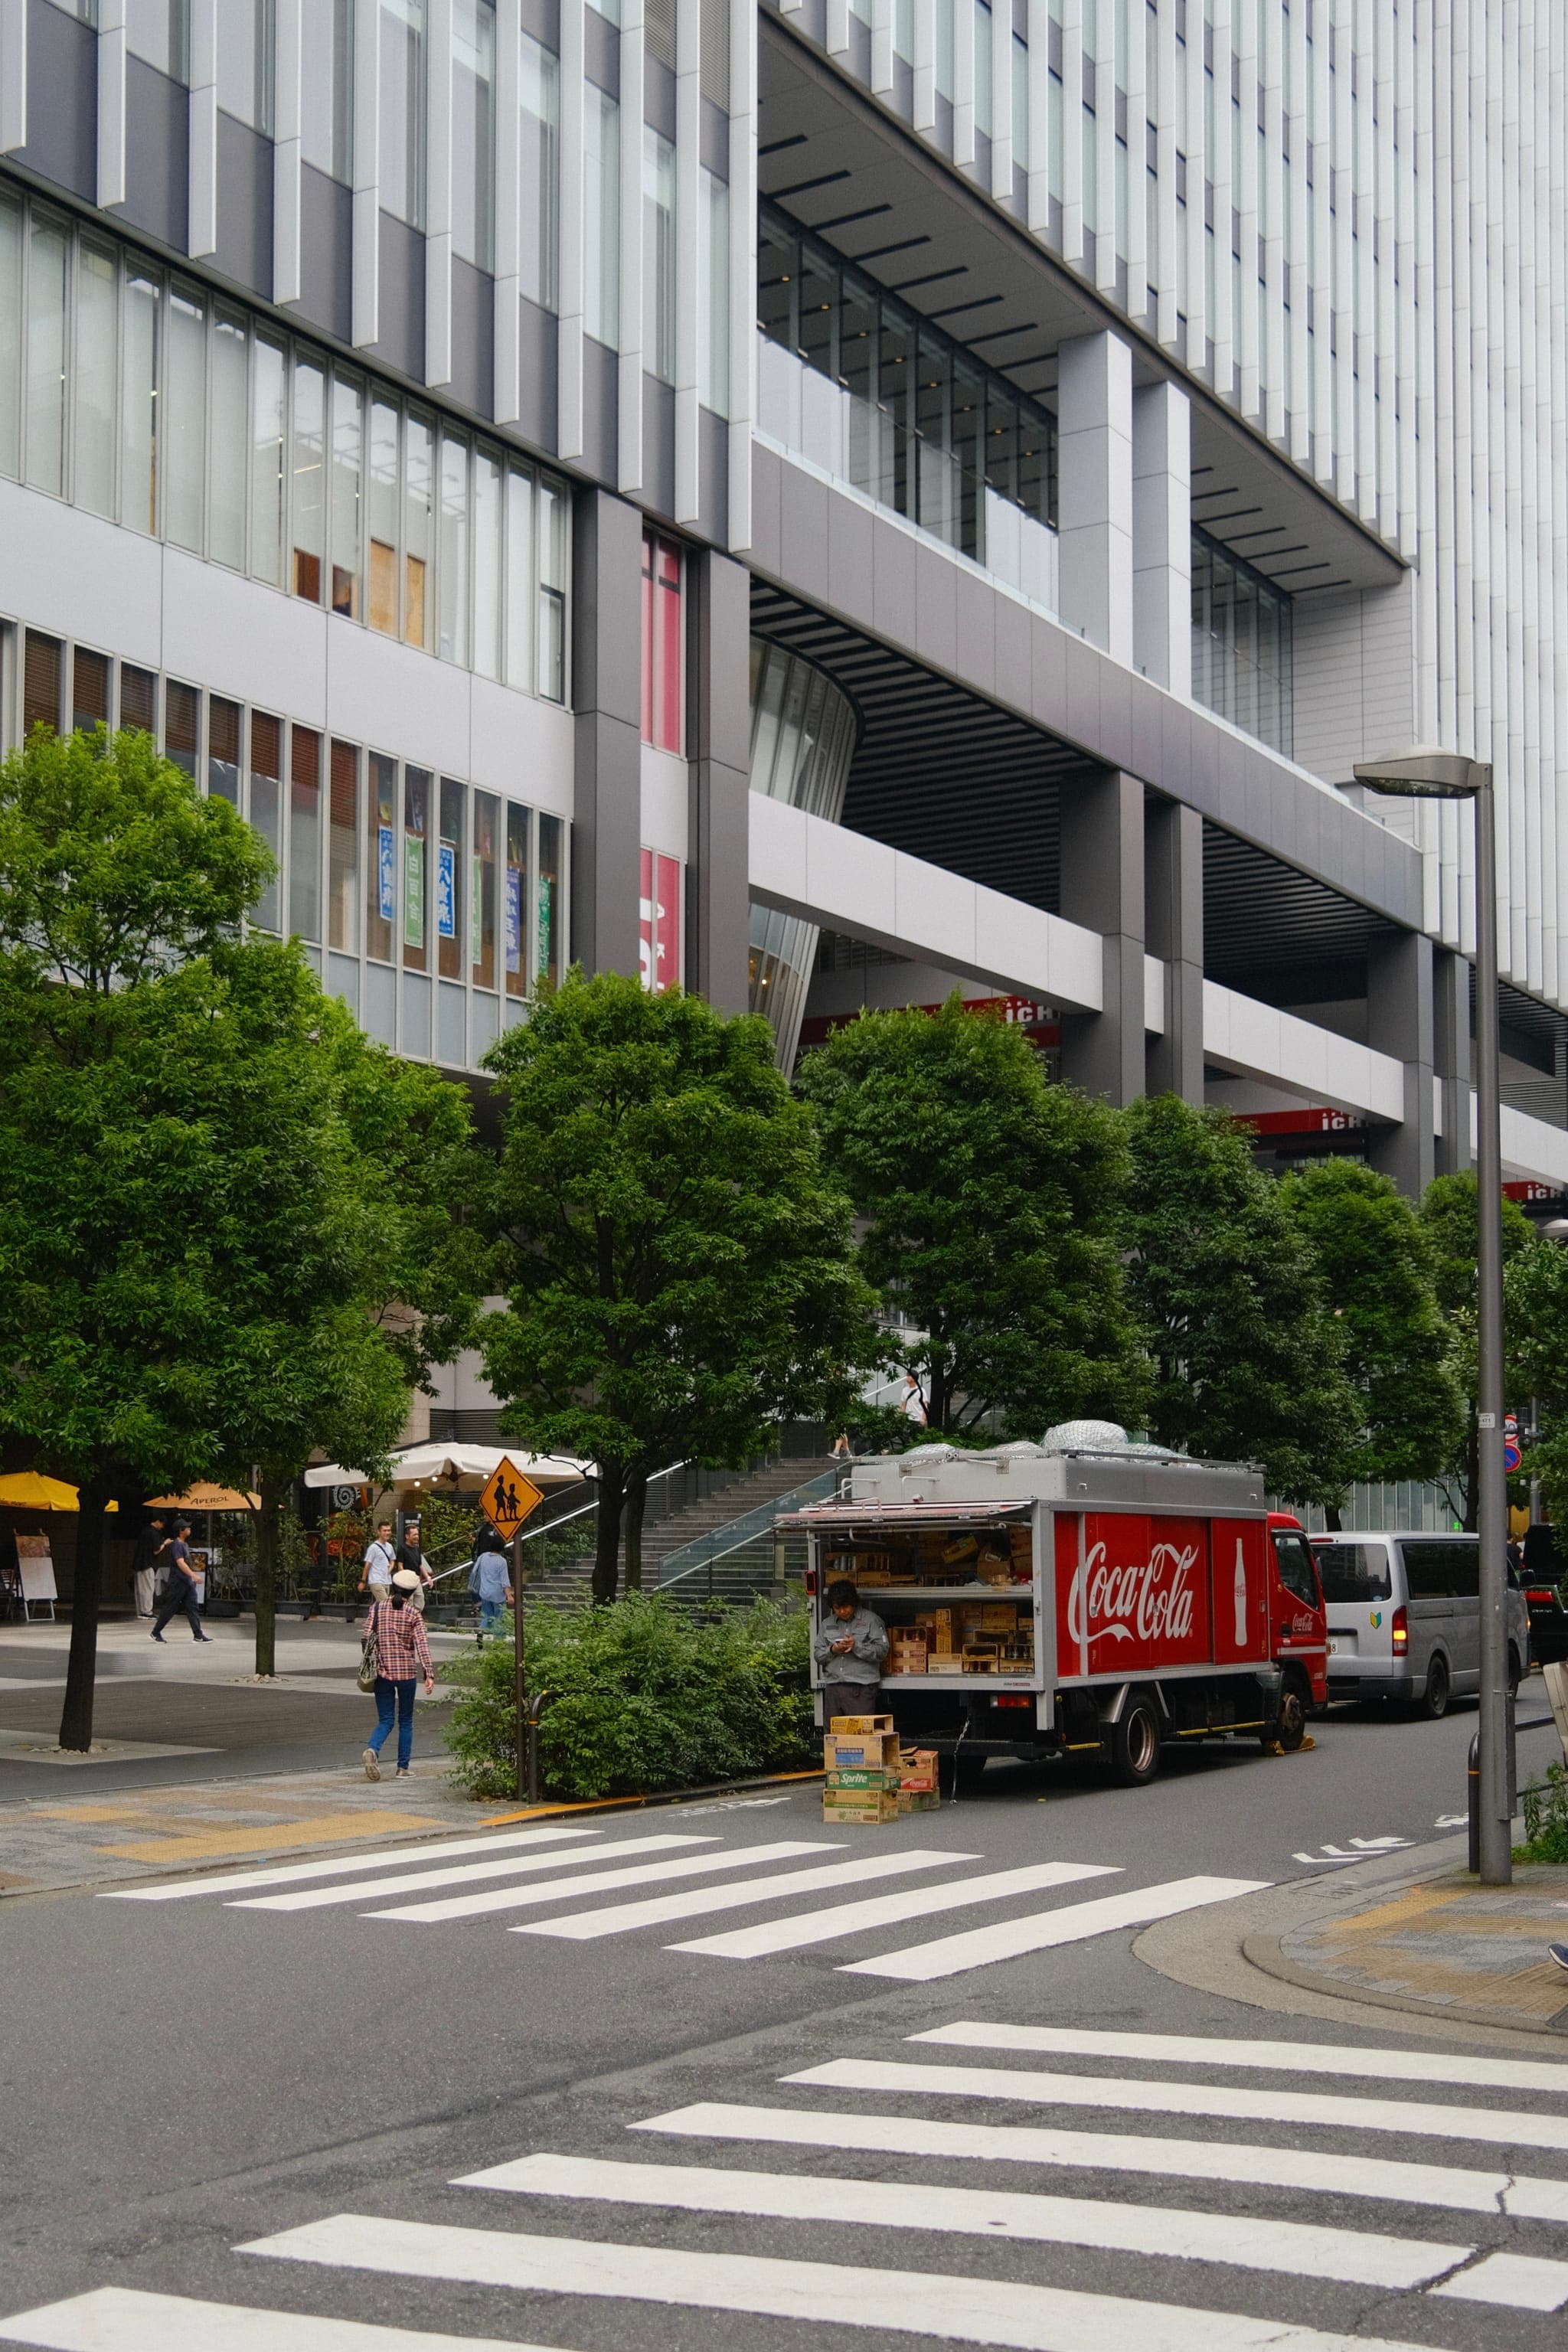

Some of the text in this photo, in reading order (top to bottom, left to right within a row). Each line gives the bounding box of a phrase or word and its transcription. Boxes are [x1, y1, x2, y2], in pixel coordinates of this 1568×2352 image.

[190, 1495, 230, 1505] APEROL
[1068, 1541, 1200, 1645] Coca-Cola
[840, 1772, 868, 1785] Sprite
